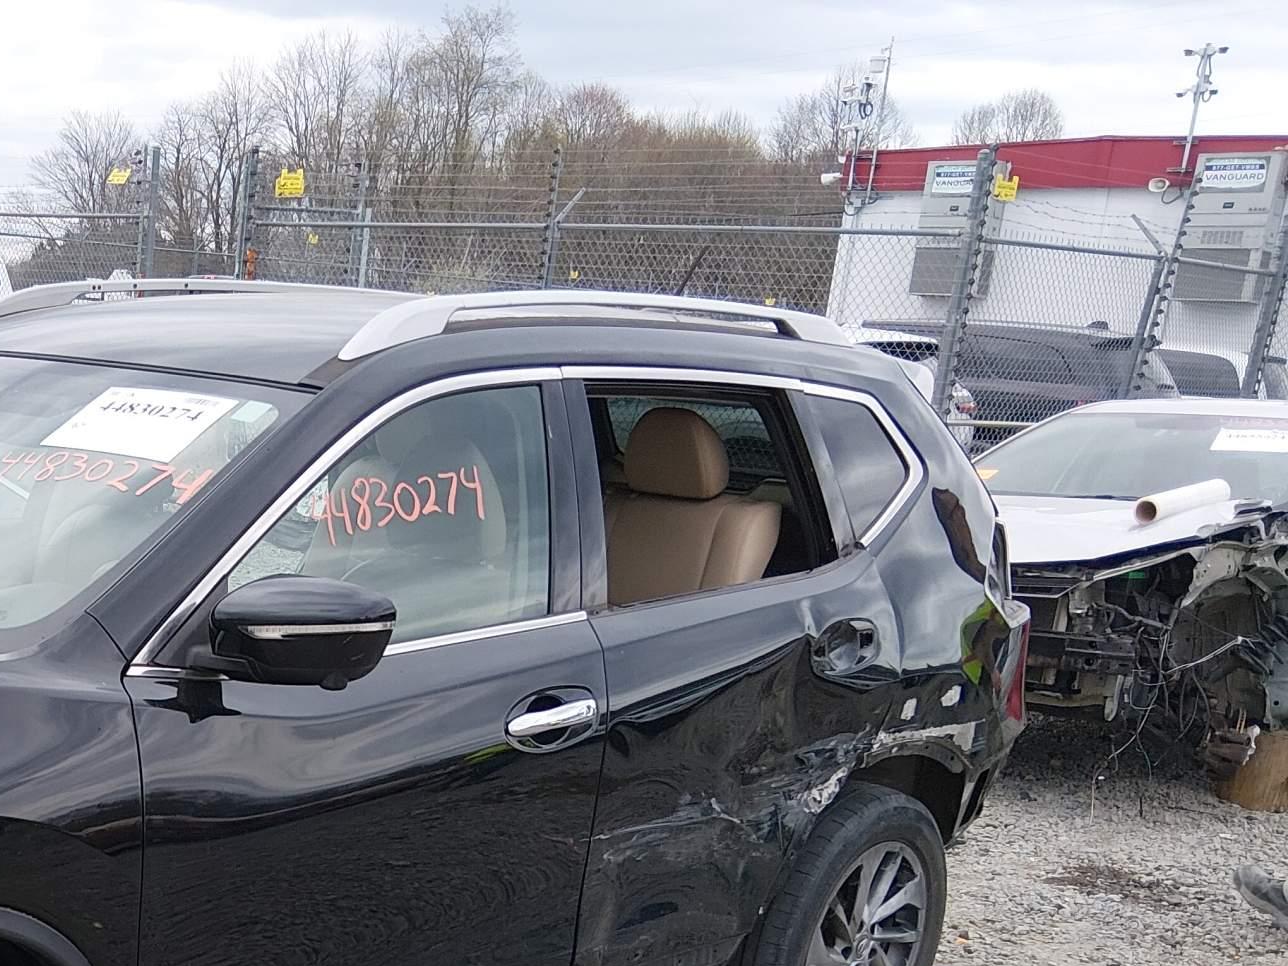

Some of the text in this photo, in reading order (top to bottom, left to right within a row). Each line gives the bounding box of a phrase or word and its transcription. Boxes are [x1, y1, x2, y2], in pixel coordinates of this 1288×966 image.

[1205, 173, 1264, 181] VANGUARD
[100, 400, 205, 421] 44830274
[311, 464, 485, 547] 44830274
